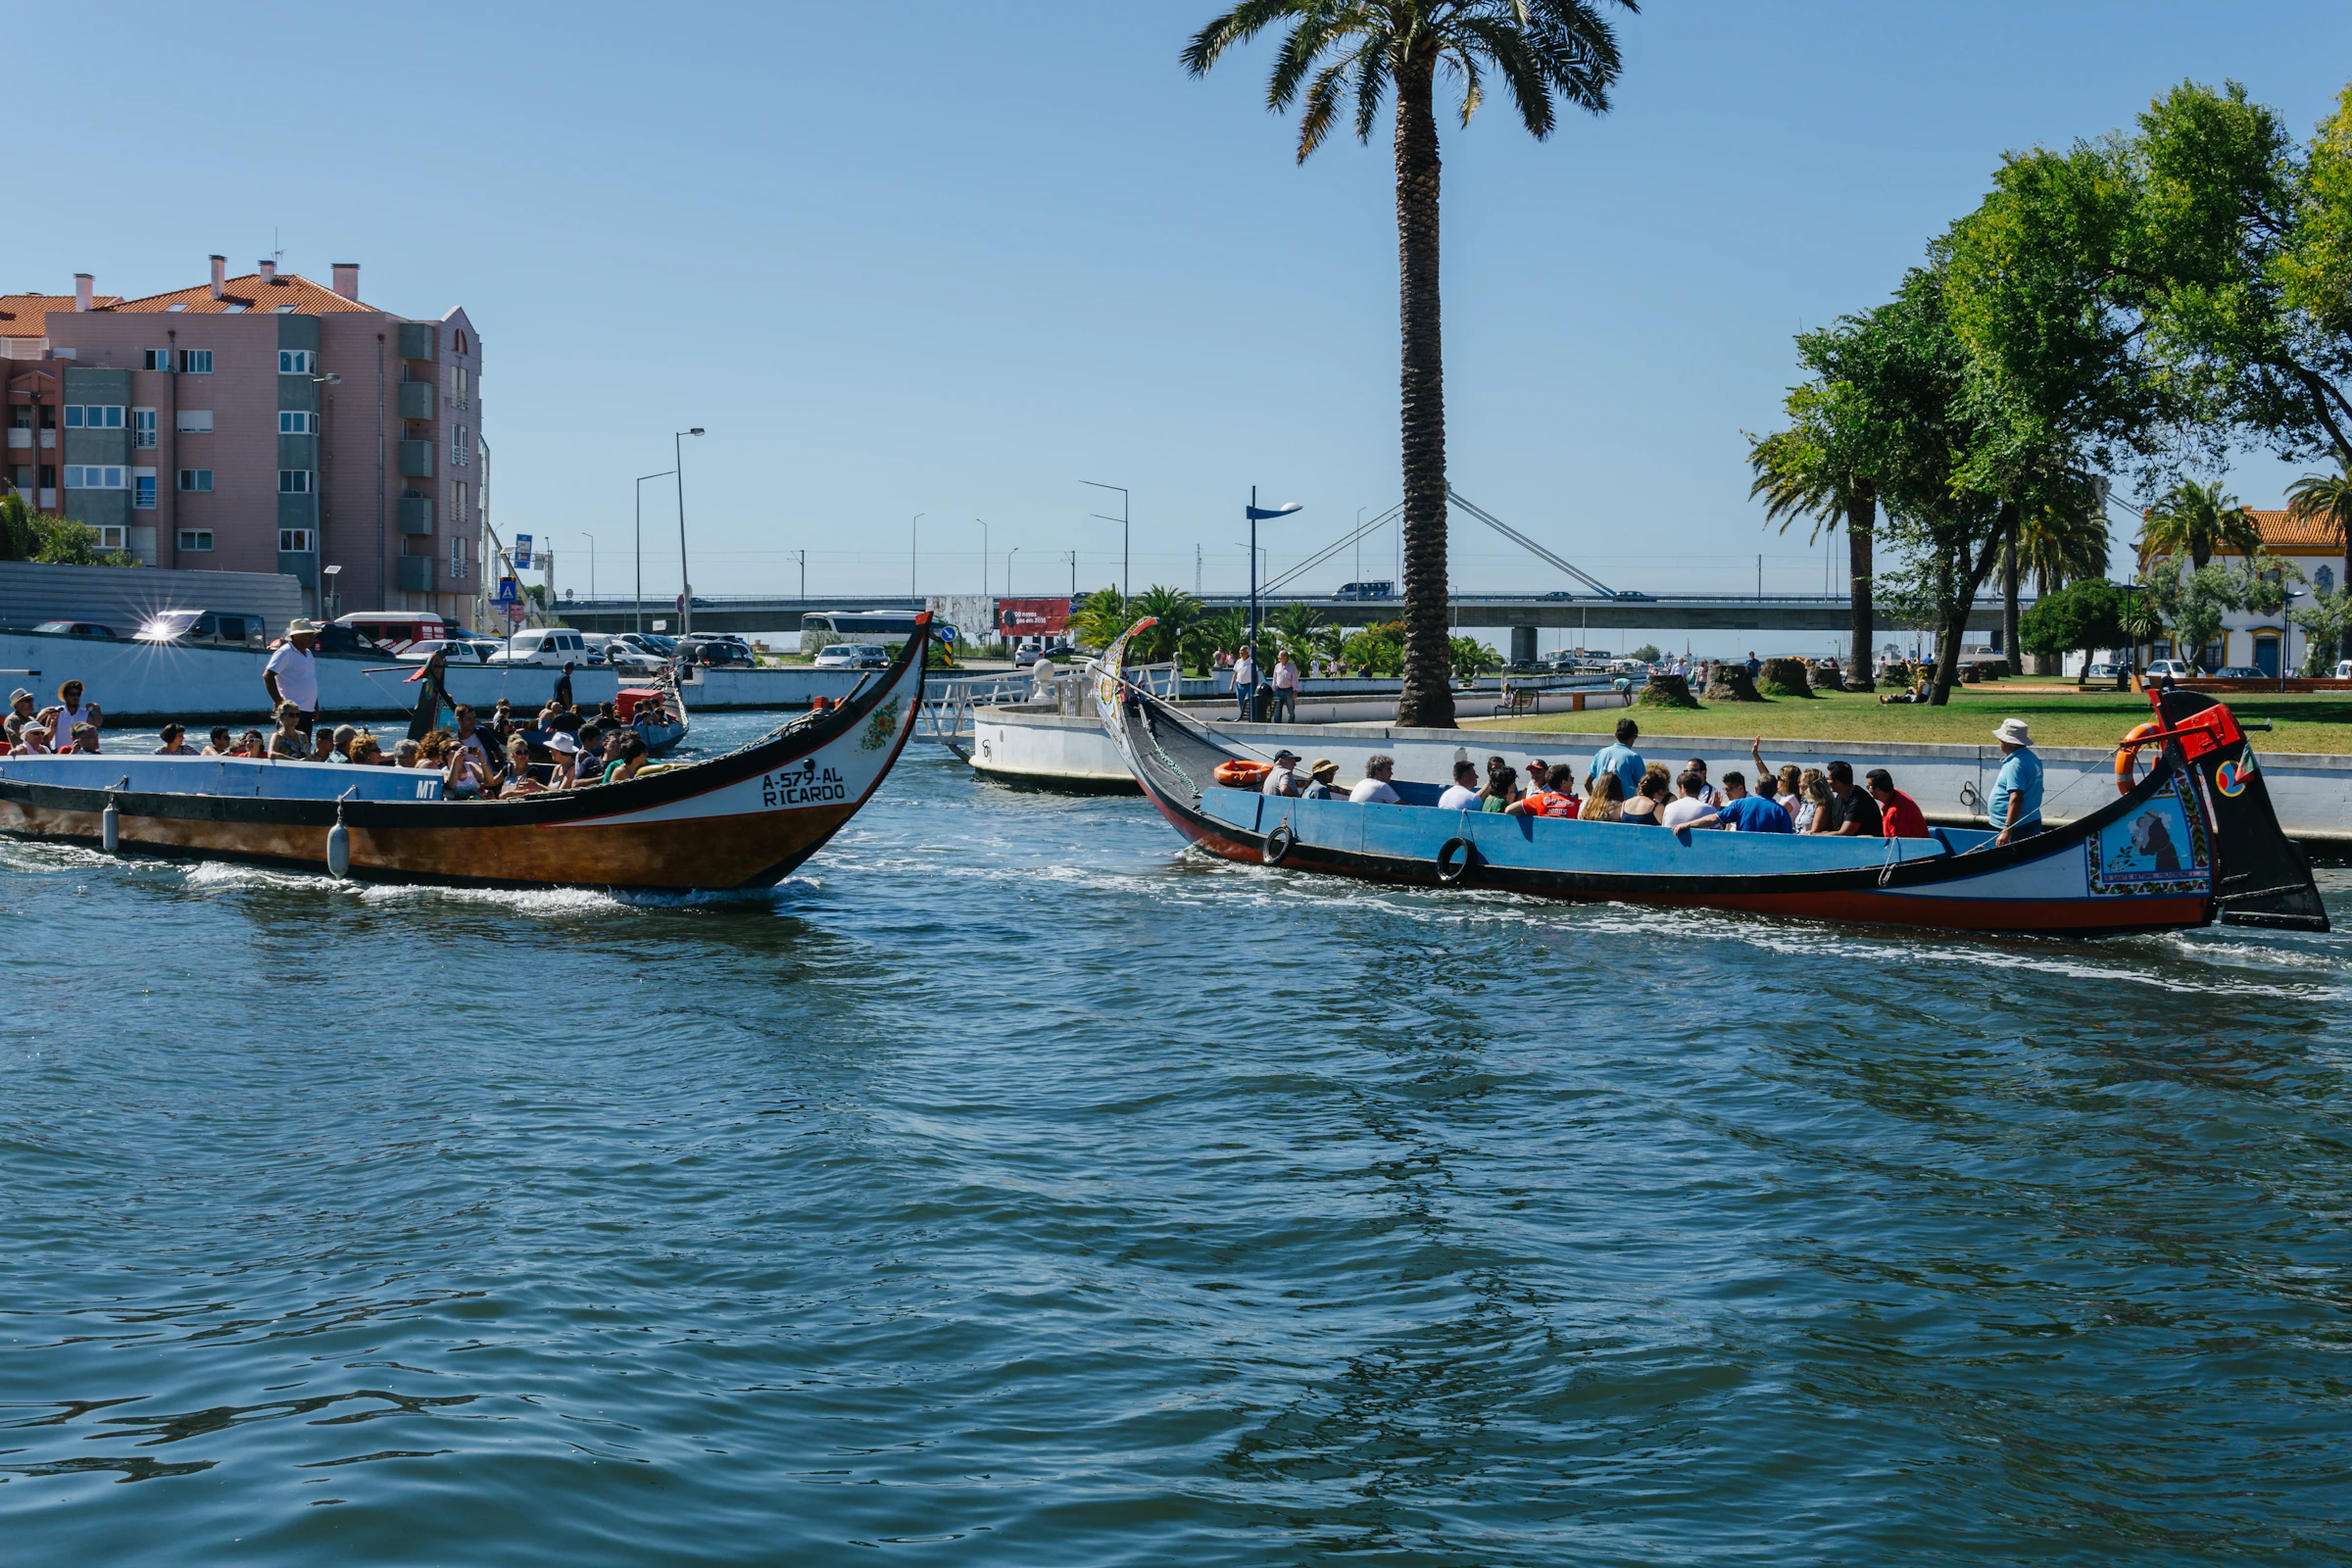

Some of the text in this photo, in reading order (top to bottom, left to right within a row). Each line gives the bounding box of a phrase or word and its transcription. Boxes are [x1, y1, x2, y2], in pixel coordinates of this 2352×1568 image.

[416, 780, 438, 799] MT
[762, 767, 843, 790] A-579-AL
[762, 784, 845, 807] RICARDO
